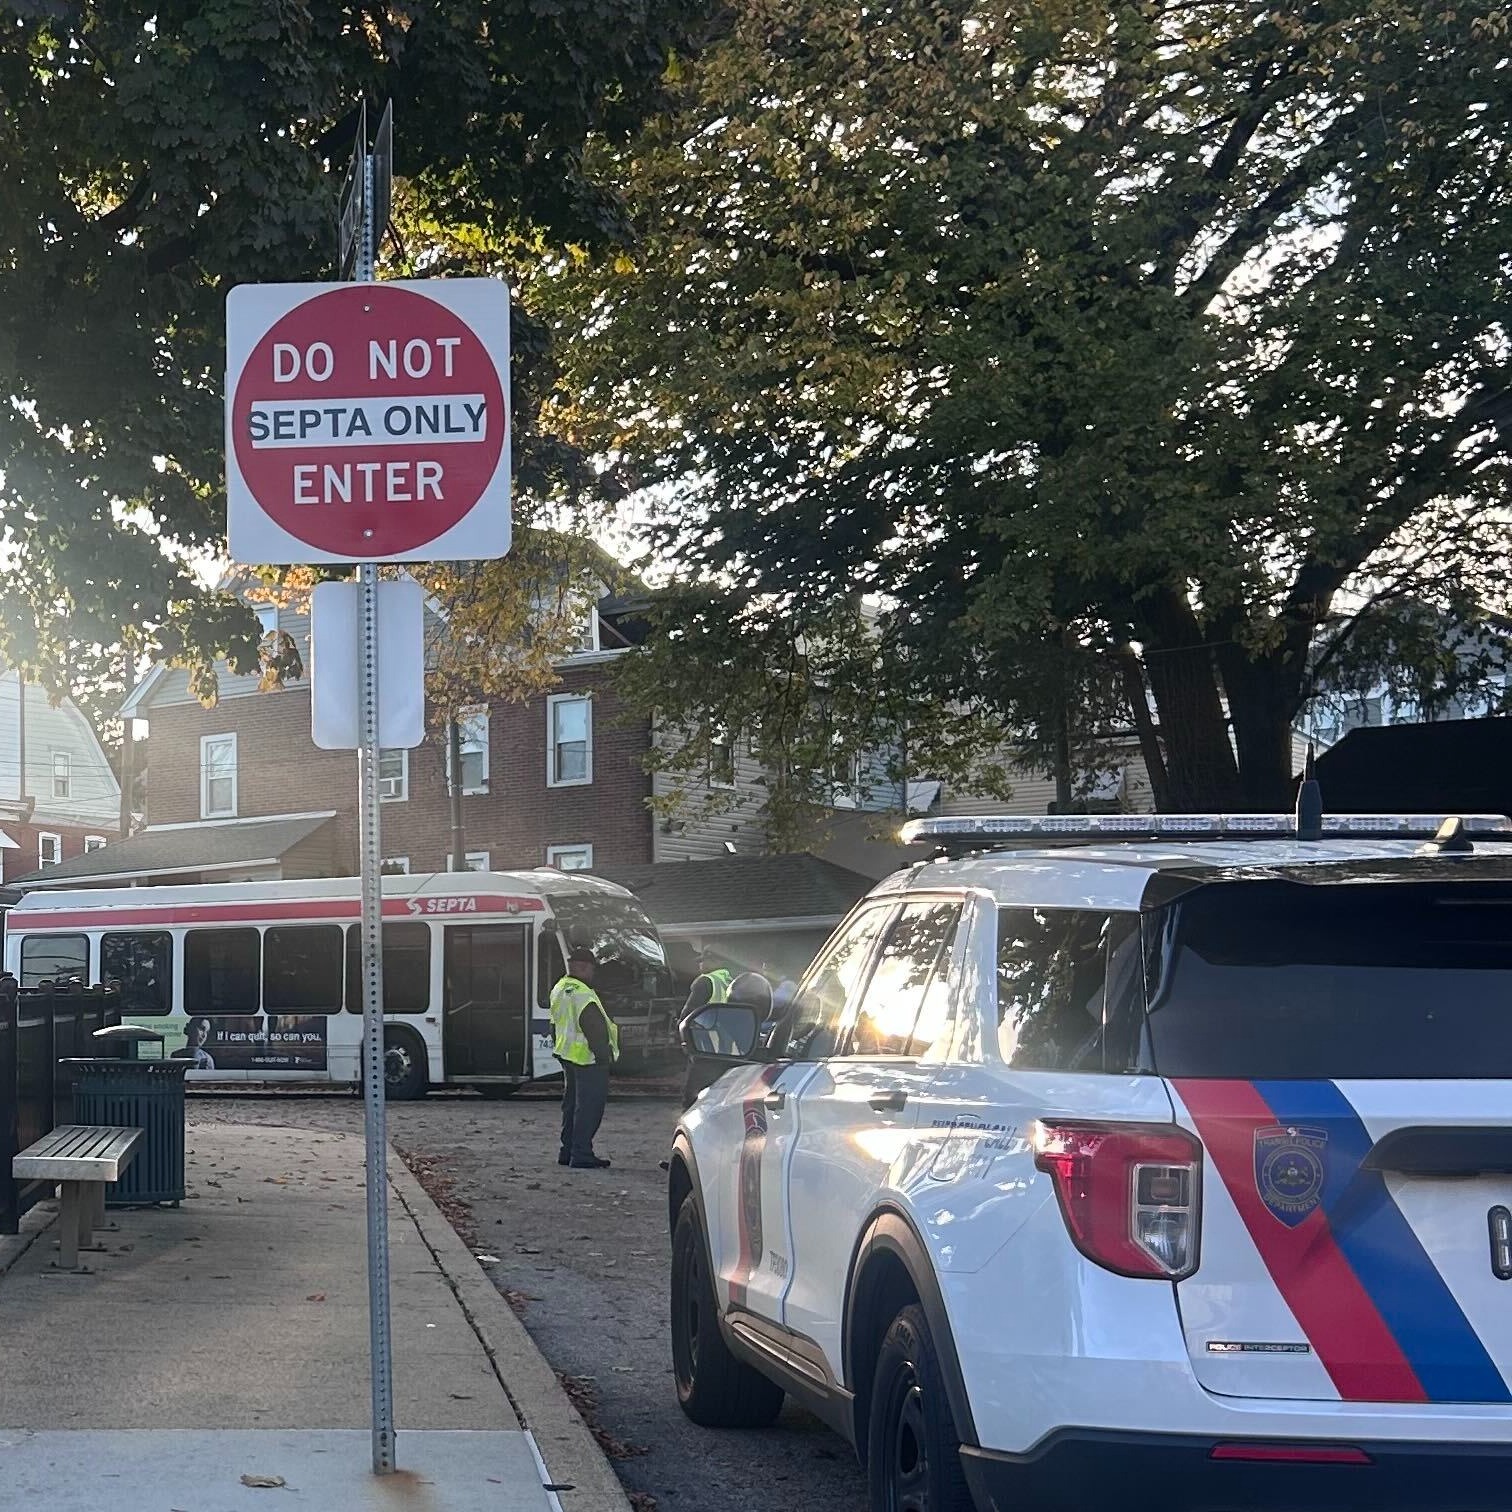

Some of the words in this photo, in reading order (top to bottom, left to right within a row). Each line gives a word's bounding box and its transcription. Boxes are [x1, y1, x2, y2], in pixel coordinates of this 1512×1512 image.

[273, 341, 334, 383] DO
[368, 337, 461, 380] NOT
[247, 407, 372, 441] SEPTA
[383, 402, 487, 435] ONLY
[293, 461, 444, 505] ENTER
[427, 897, 478, 912] SEPTA
[230, 1032, 246, 1041] can
[270, 1032, 281, 1041] so
[283, 1032, 300, 1041] can
[1209, 1343, 1242, 1351] POLICE
